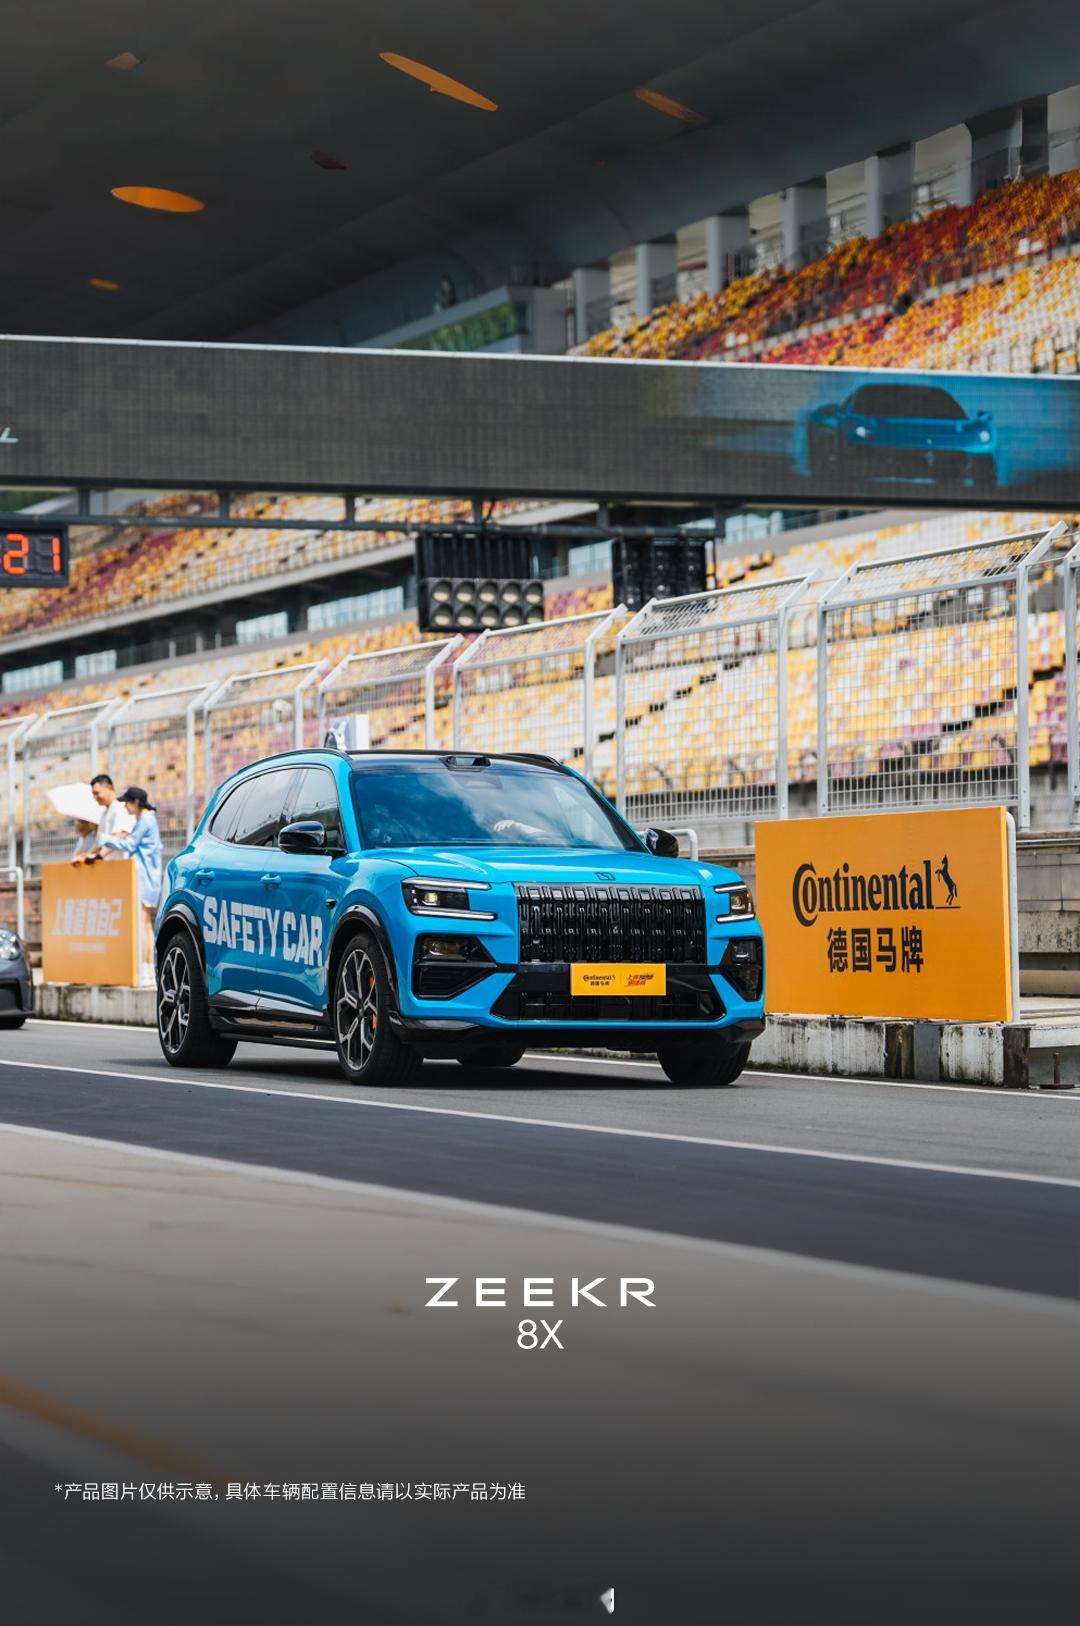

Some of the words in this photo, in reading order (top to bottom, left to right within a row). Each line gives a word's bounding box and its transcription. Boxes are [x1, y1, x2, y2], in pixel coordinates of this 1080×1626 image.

[792, 859, 935, 927] Continental
[203, 896, 281, 957] SAFETY
[282, 911, 323, 967] CAR
[827, 926, 924, 974] 德国马牌
